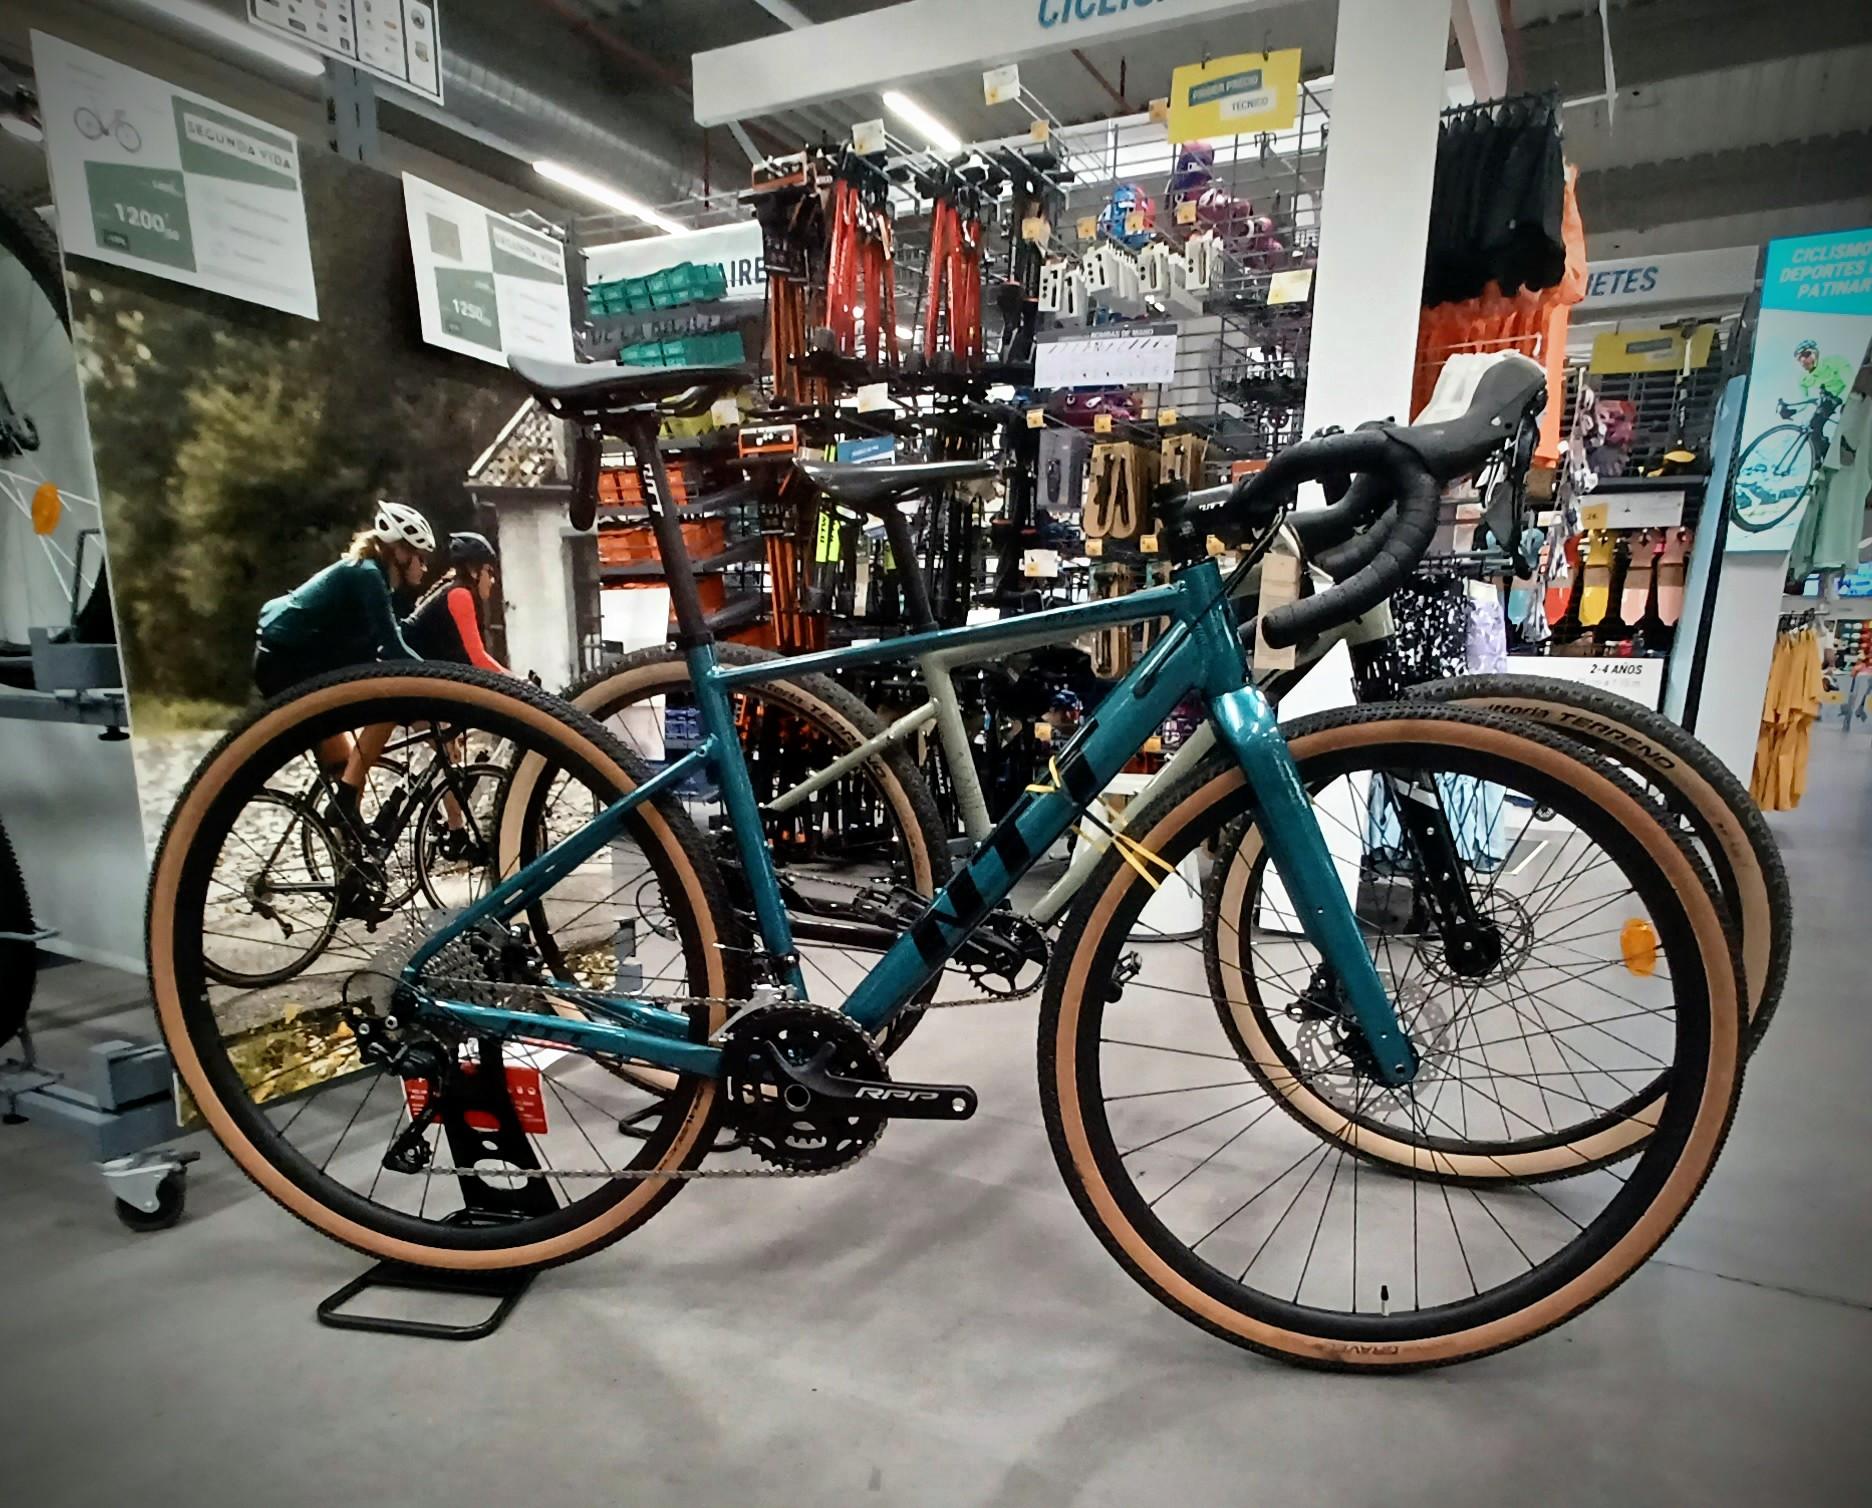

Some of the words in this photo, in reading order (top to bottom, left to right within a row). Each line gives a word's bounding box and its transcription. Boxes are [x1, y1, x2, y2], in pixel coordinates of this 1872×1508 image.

[1780, 260, 1866, 284] DEPORTES
[1560, 711, 1676, 770] TERRENO
[856, 1086, 940, 1102] RPP
